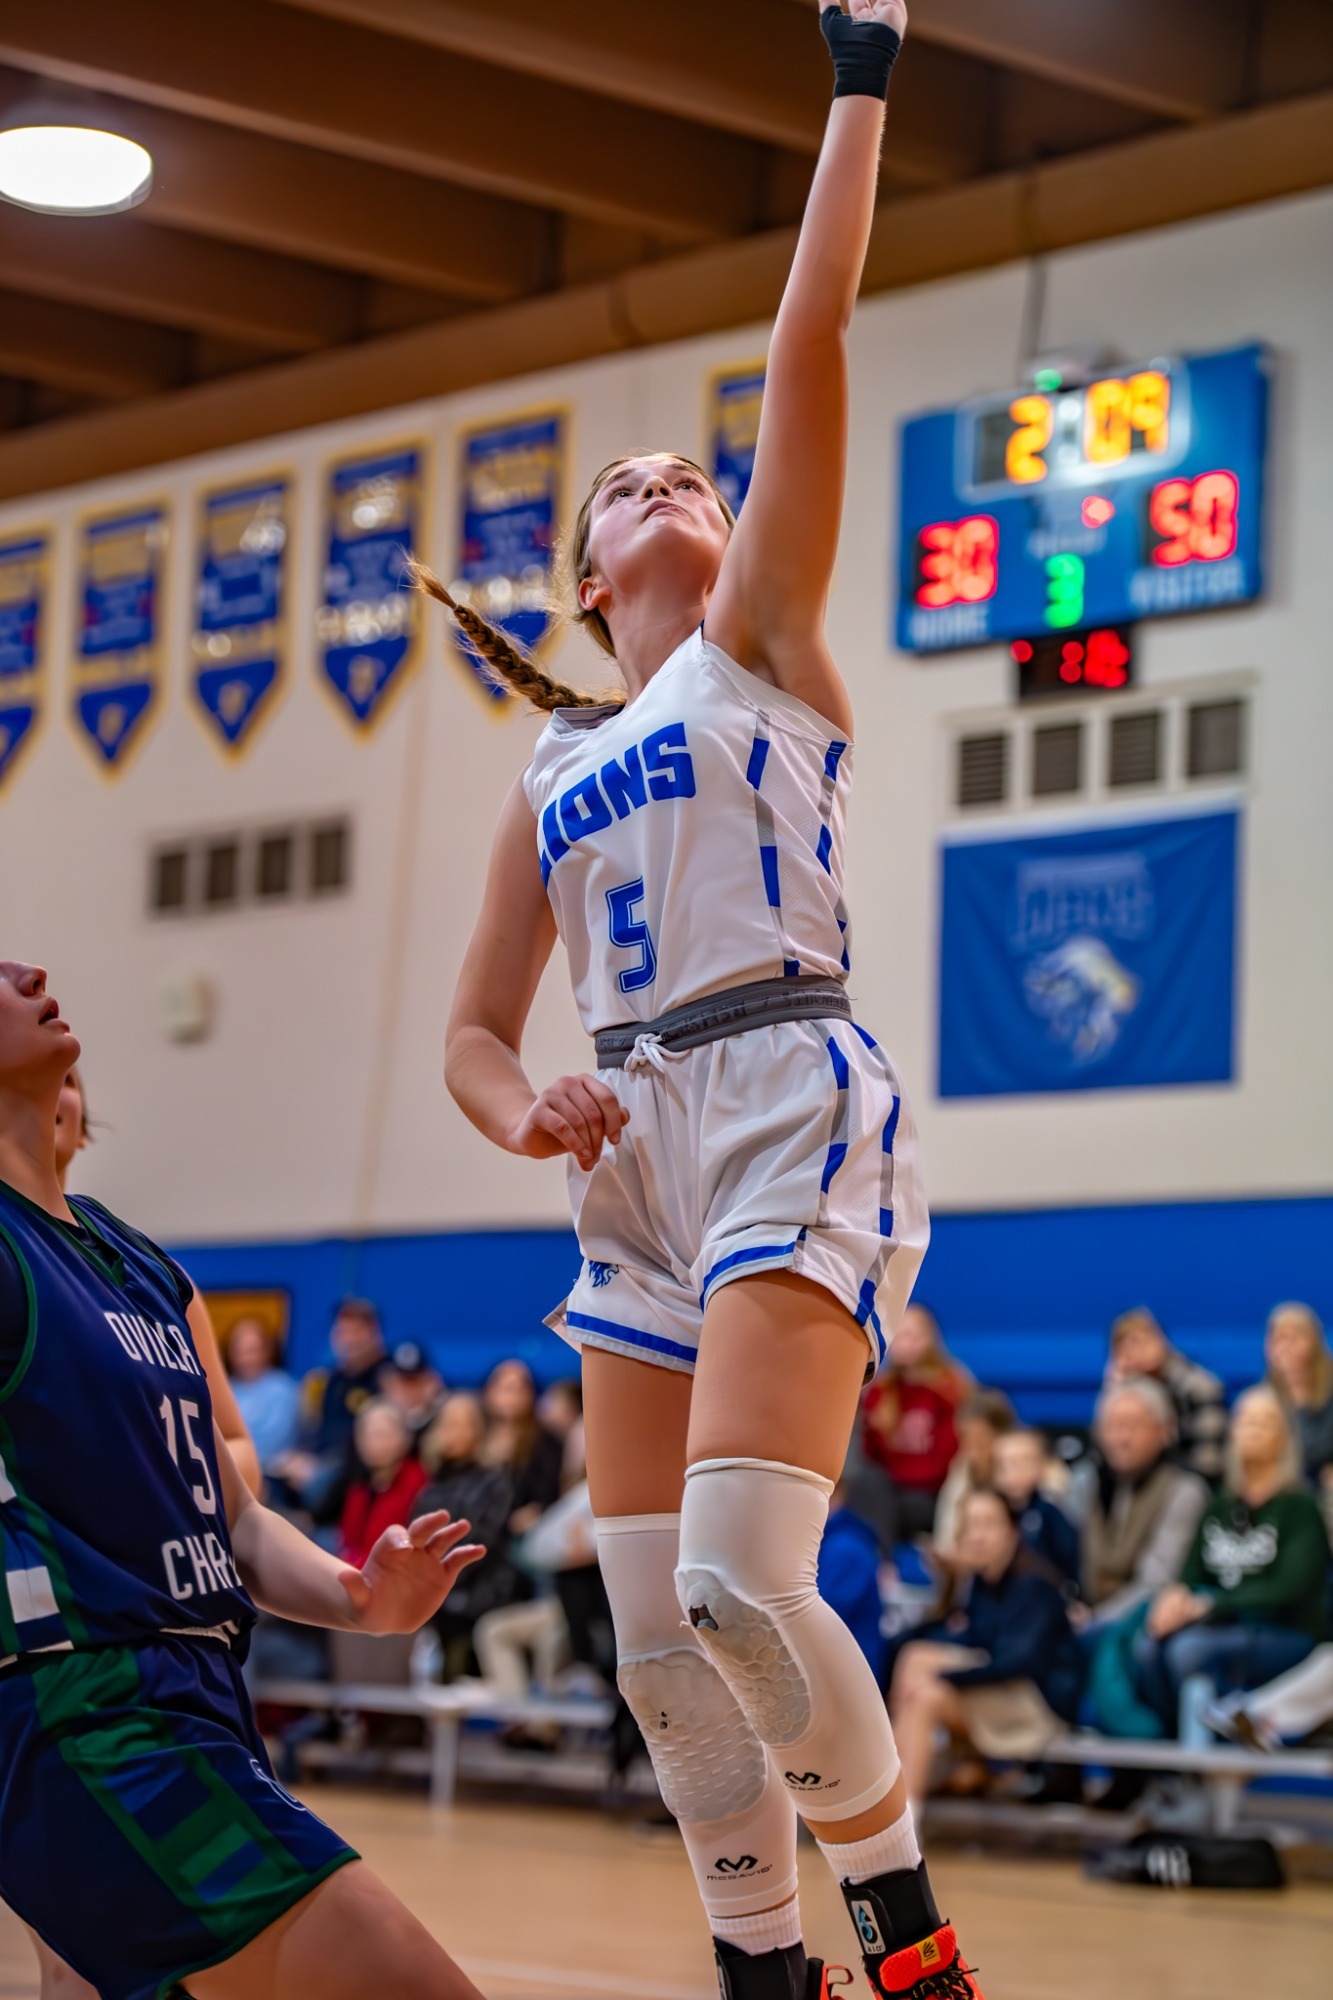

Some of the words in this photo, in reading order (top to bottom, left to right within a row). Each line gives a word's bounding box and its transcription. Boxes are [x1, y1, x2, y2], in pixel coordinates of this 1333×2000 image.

[916, 514, 999, 610] 30
[1149, 469, 1240, 569] 50
[1043, 552, 1085, 628] 3
[604, 875, 657, 994] 5
[159, 1394, 216, 1515] 15
